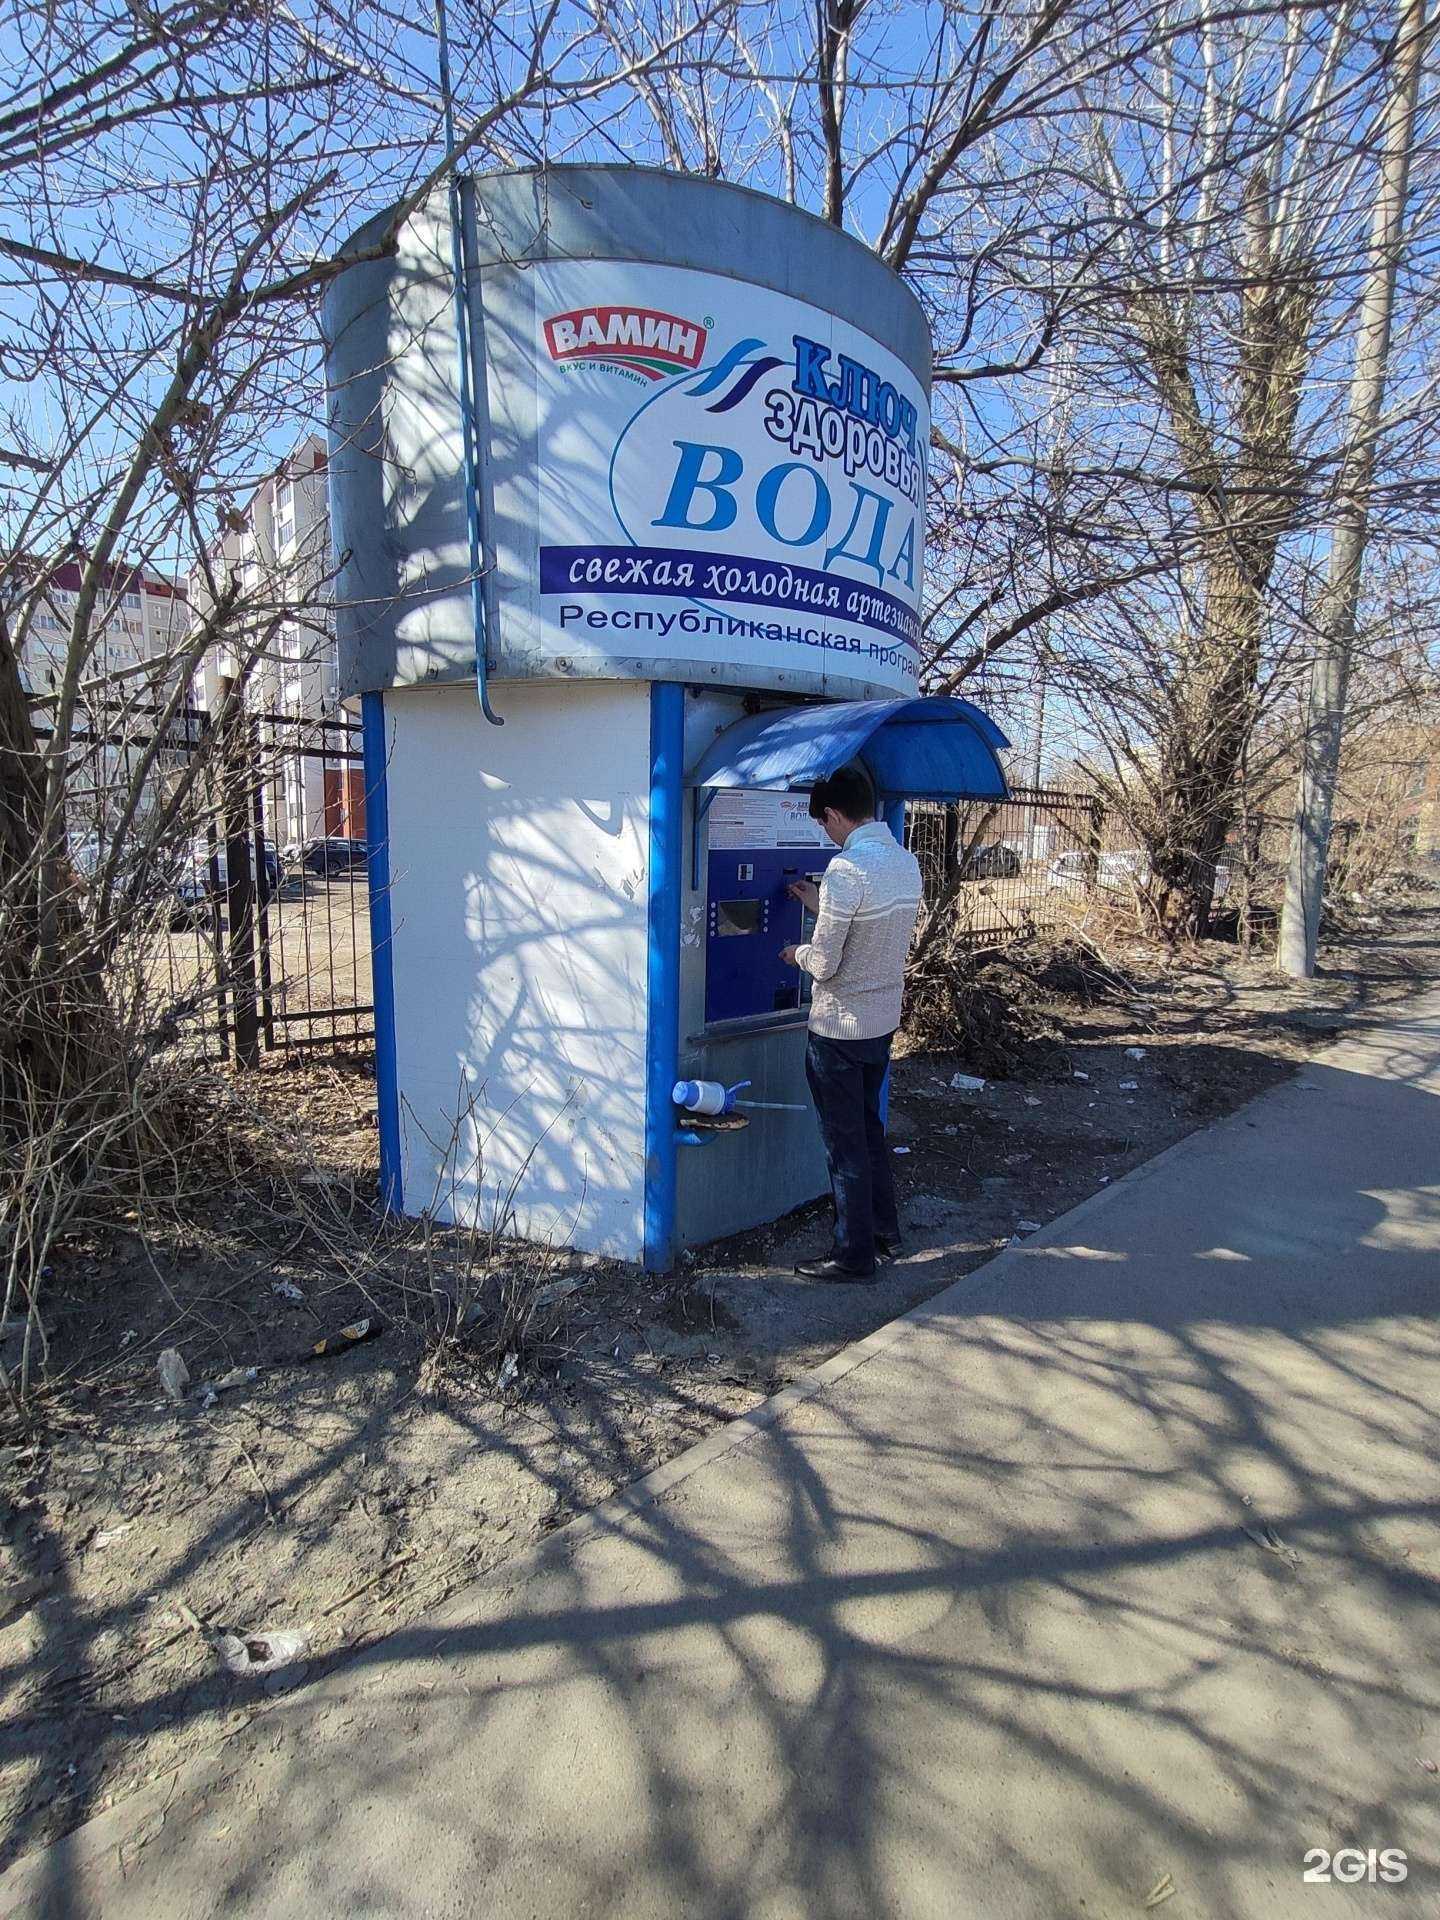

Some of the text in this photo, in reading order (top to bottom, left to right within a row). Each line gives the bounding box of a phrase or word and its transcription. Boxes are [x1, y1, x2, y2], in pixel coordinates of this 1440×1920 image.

[551, 313, 698, 360] ВАМИН
[559, 361, 648, 388] ВКУС И ВИТАМИН
[792, 334, 918, 460] КЛЮЧ
[650, 440, 915, 592] ВОДА
[569, 557, 695, 588] свежая
[702, 565, 840, 609] холодная
[559, 604, 861, 655] Республиканская
